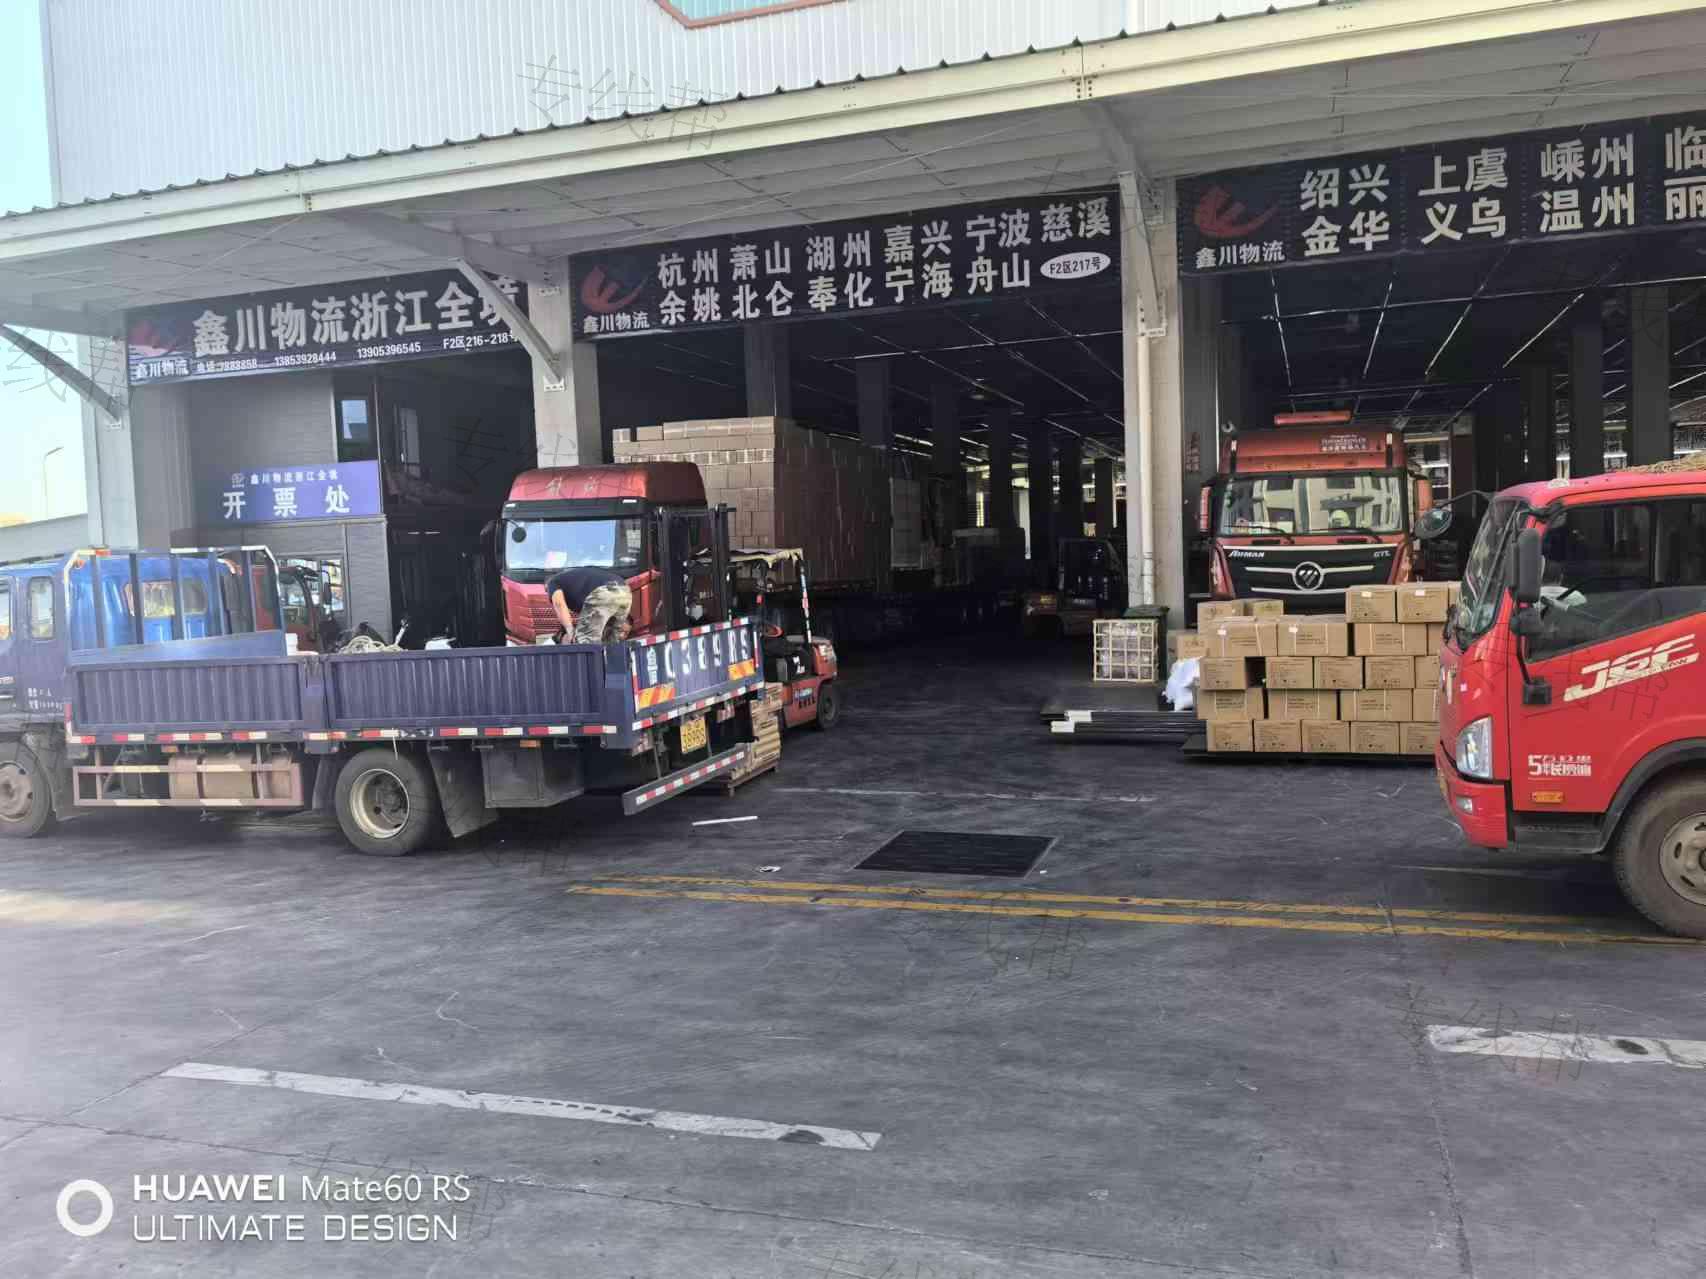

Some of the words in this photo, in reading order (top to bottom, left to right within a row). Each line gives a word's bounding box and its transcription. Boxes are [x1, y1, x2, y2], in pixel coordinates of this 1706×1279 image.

[1299, 163, 1390, 211] 绍兴
[1418, 148, 1508, 196] 上虞
[1540, 134, 1635, 184] 嵊州
[657, 249, 719, 290] 杭州
[729, 241, 792, 281] 萧山
[807, 231, 873, 272] 湖州
[883, 223, 952, 264] 嘉兴
[966, 210, 1032, 252] 宁波
[1040, 197, 1111, 243] 慈溪
[1303, 210, 1391, 256] 金华
[1421, 197, 1507, 245] 义乌
[1540, 183, 1636, 233] 温州
[1049, 257, 1101, 275] F2区217号
[1195, 240, 1286, 269] 鑫川物流
[658, 287, 722, 326] 余姚
[731, 279, 794, 320] 北仑
[808, 268, 874, 313] 奉化
[885, 261, 953, 304] 宁海
[967, 252, 1031, 294] 舟山
[583, 310, 650, 334] 鑫川物流
[223, 484, 350, 519] 开票处
